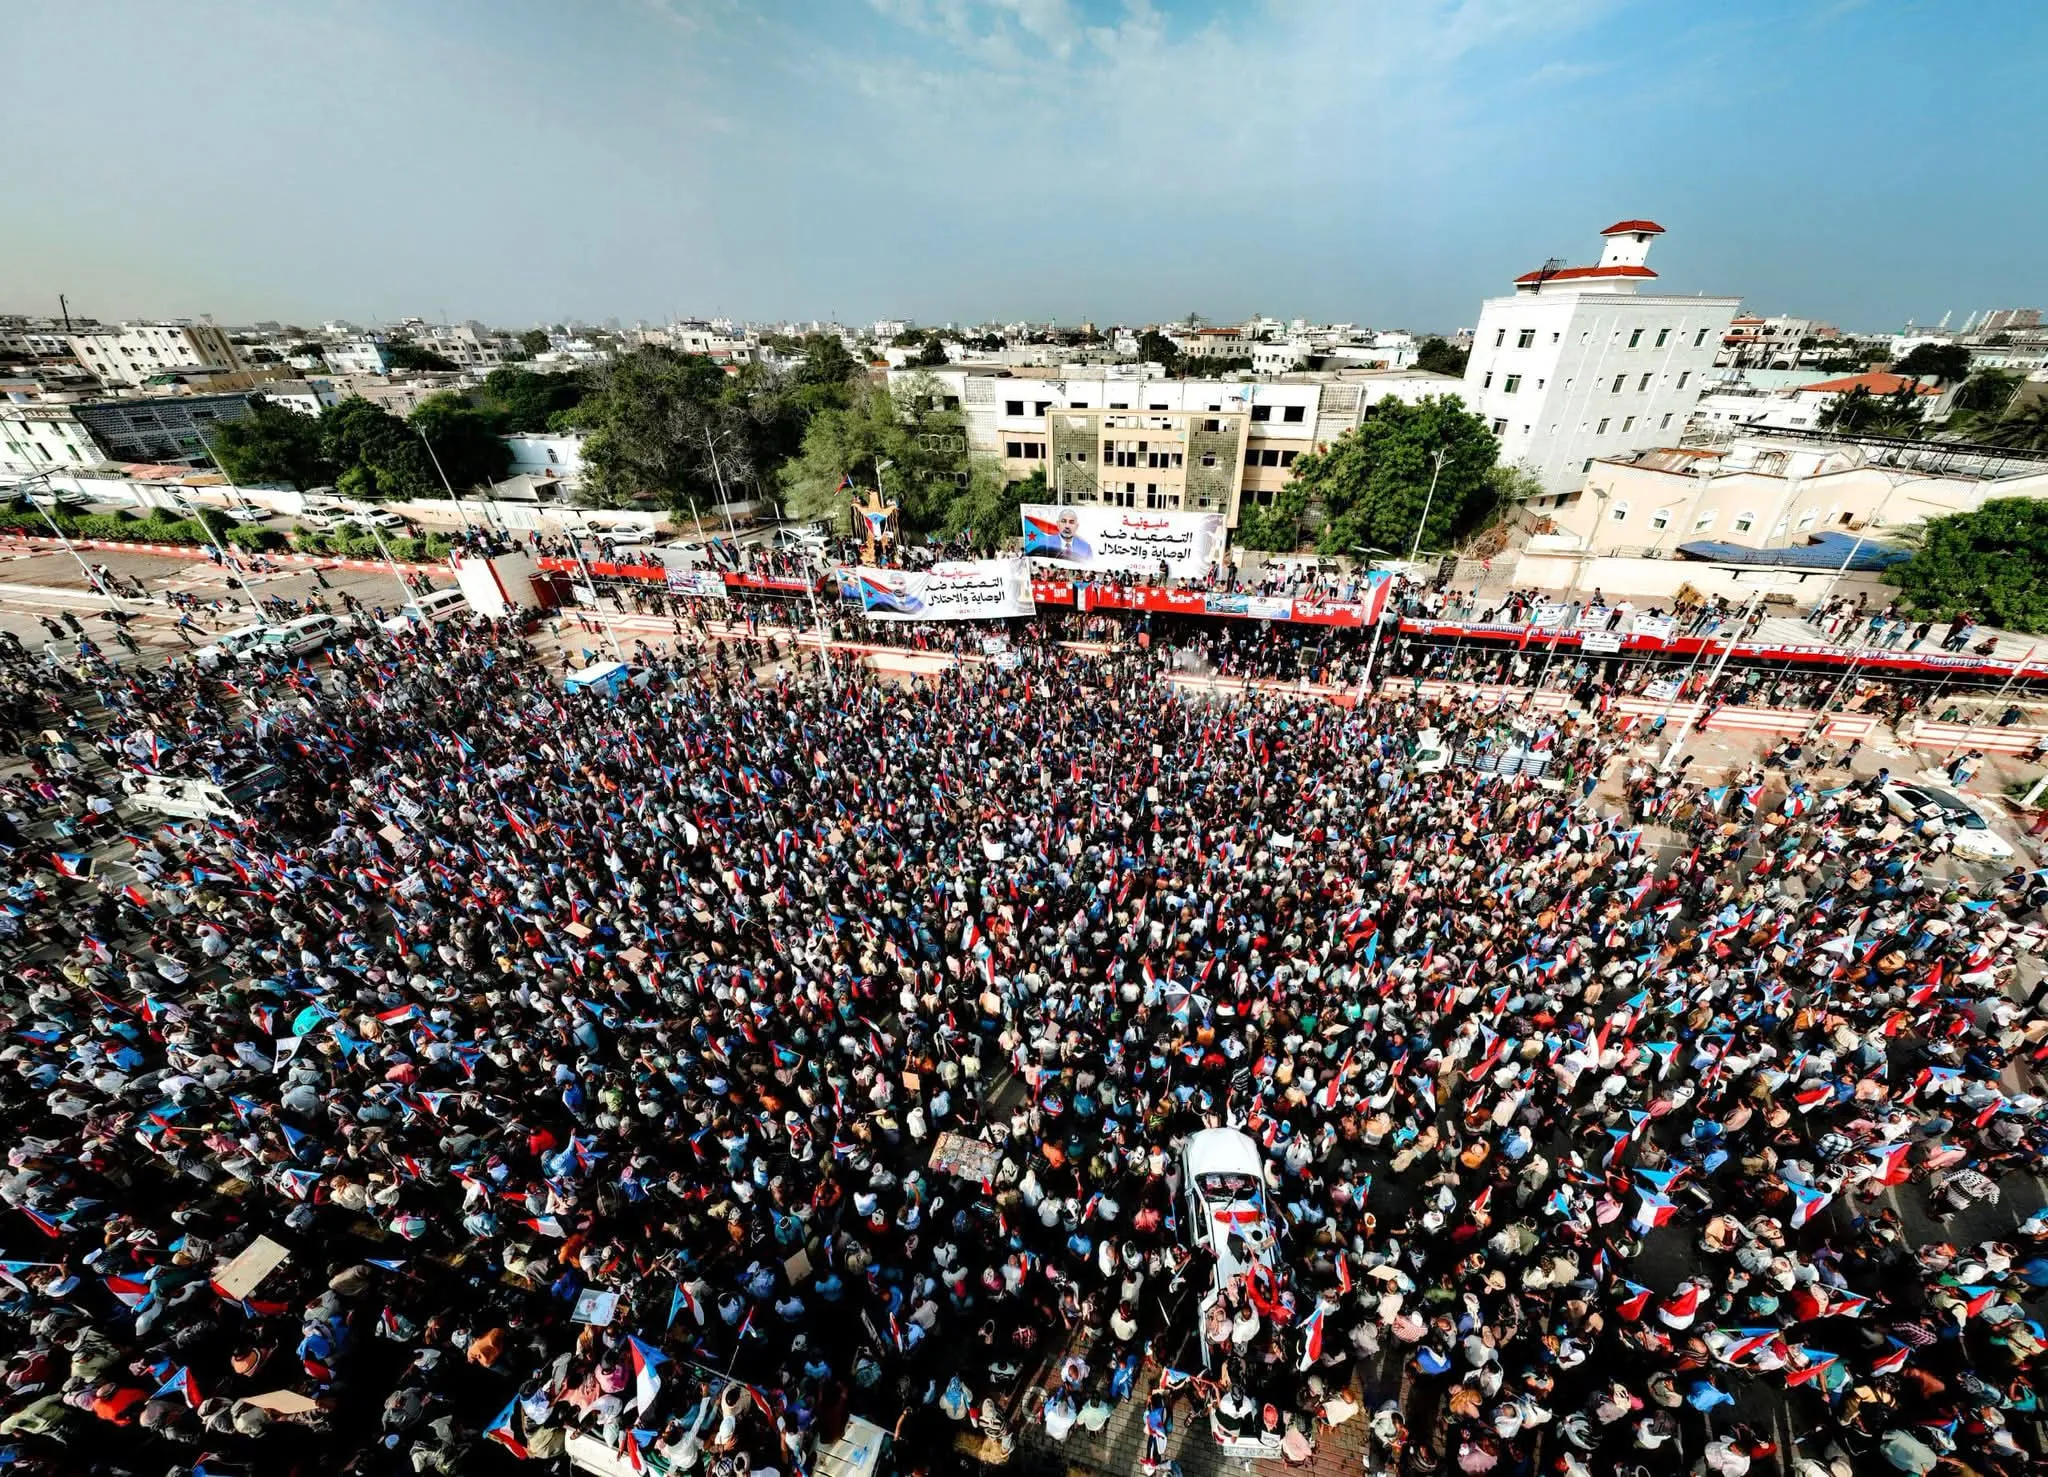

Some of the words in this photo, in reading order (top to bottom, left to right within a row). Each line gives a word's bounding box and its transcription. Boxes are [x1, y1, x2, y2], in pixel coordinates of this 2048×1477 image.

[1122, 515, 1170, 531] مليونية
[1100, 529, 1127, 539] ضد
[1130, 531, 1193, 545] التصعيد
[1098, 542, 1148, 559] والاحتلال
[1151, 545, 1191, 562] الوصاية
[925, 581, 947, 592] ضد
[950, 577, 1003, 591] التصعيد
[928, 592, 969, 607] والاحتلال
[970, 591, 1005, 605] الوصاية
